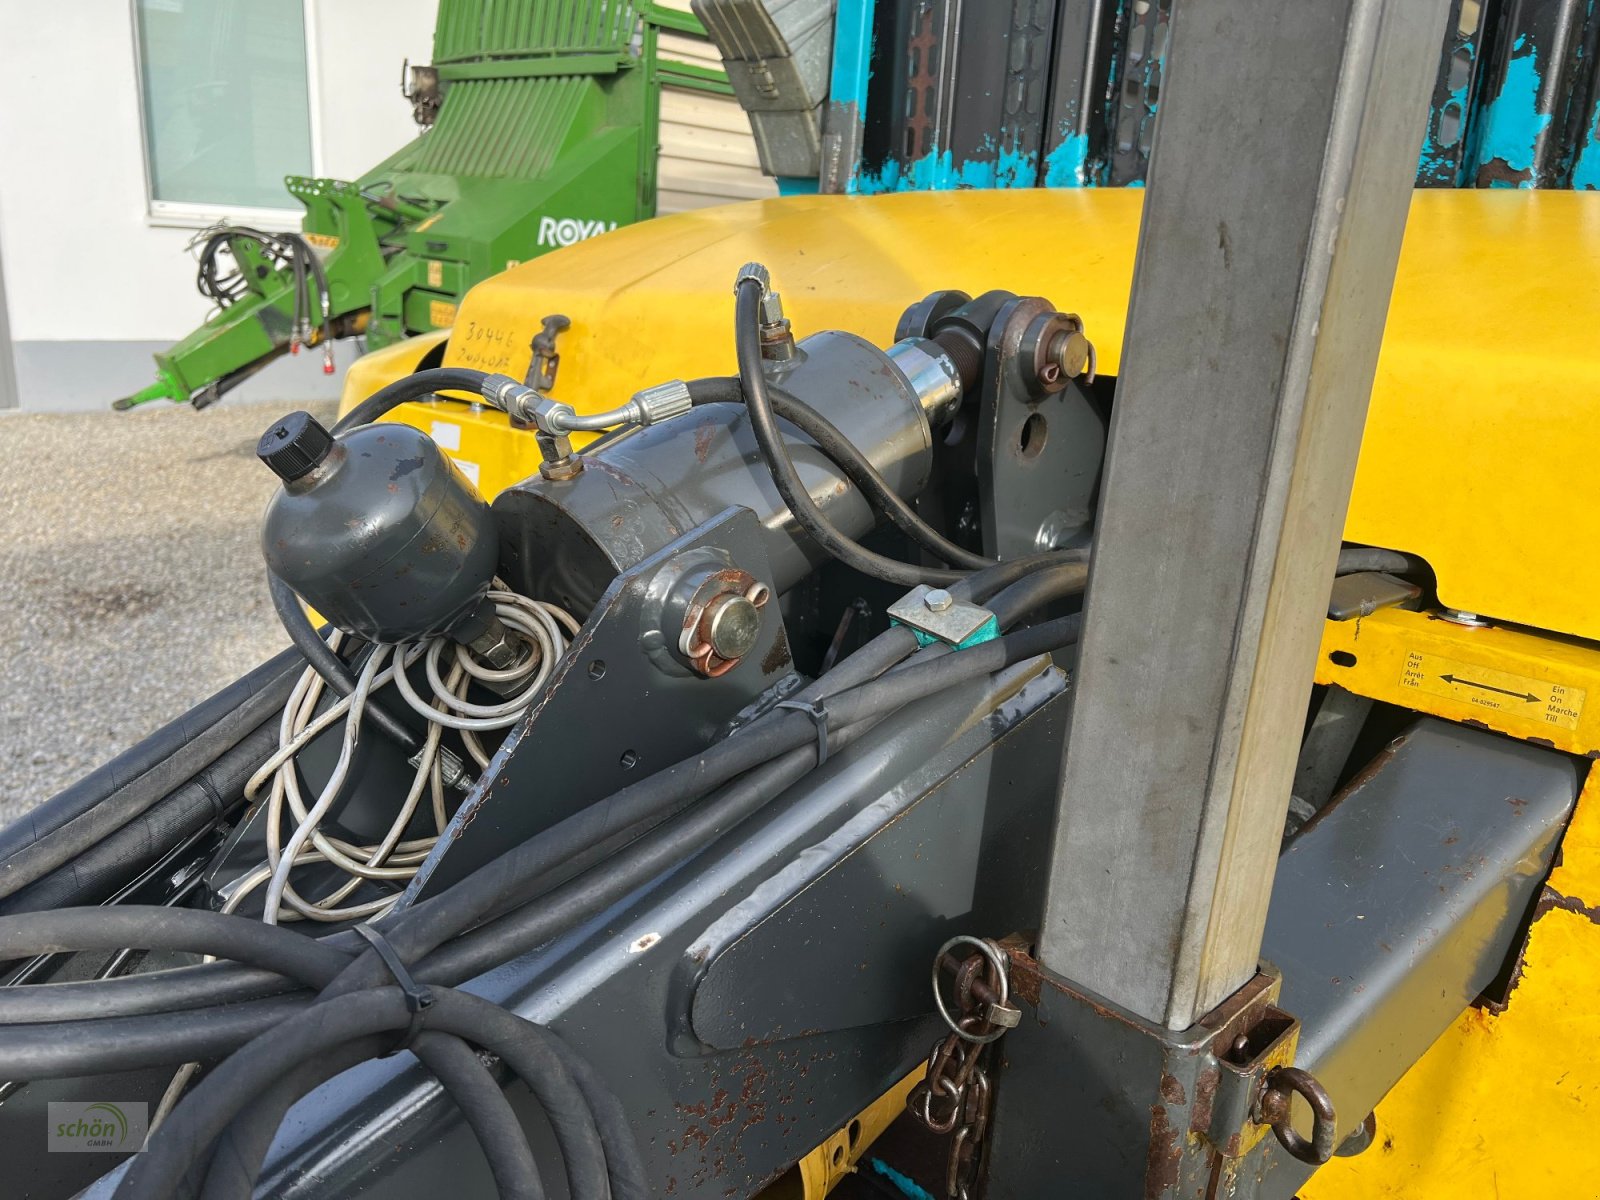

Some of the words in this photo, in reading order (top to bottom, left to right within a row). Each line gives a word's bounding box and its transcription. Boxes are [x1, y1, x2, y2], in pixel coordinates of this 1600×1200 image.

[1409, 652, 1423, 661] Aus
[1407, 660, 1420, 669] Off
[1552, 686, 1565, 694] Ein
[1550, 696, 1562, 704] On
[1547, 704, 1578, 718] Marche
[1545, 714, 1558, 722] Till
